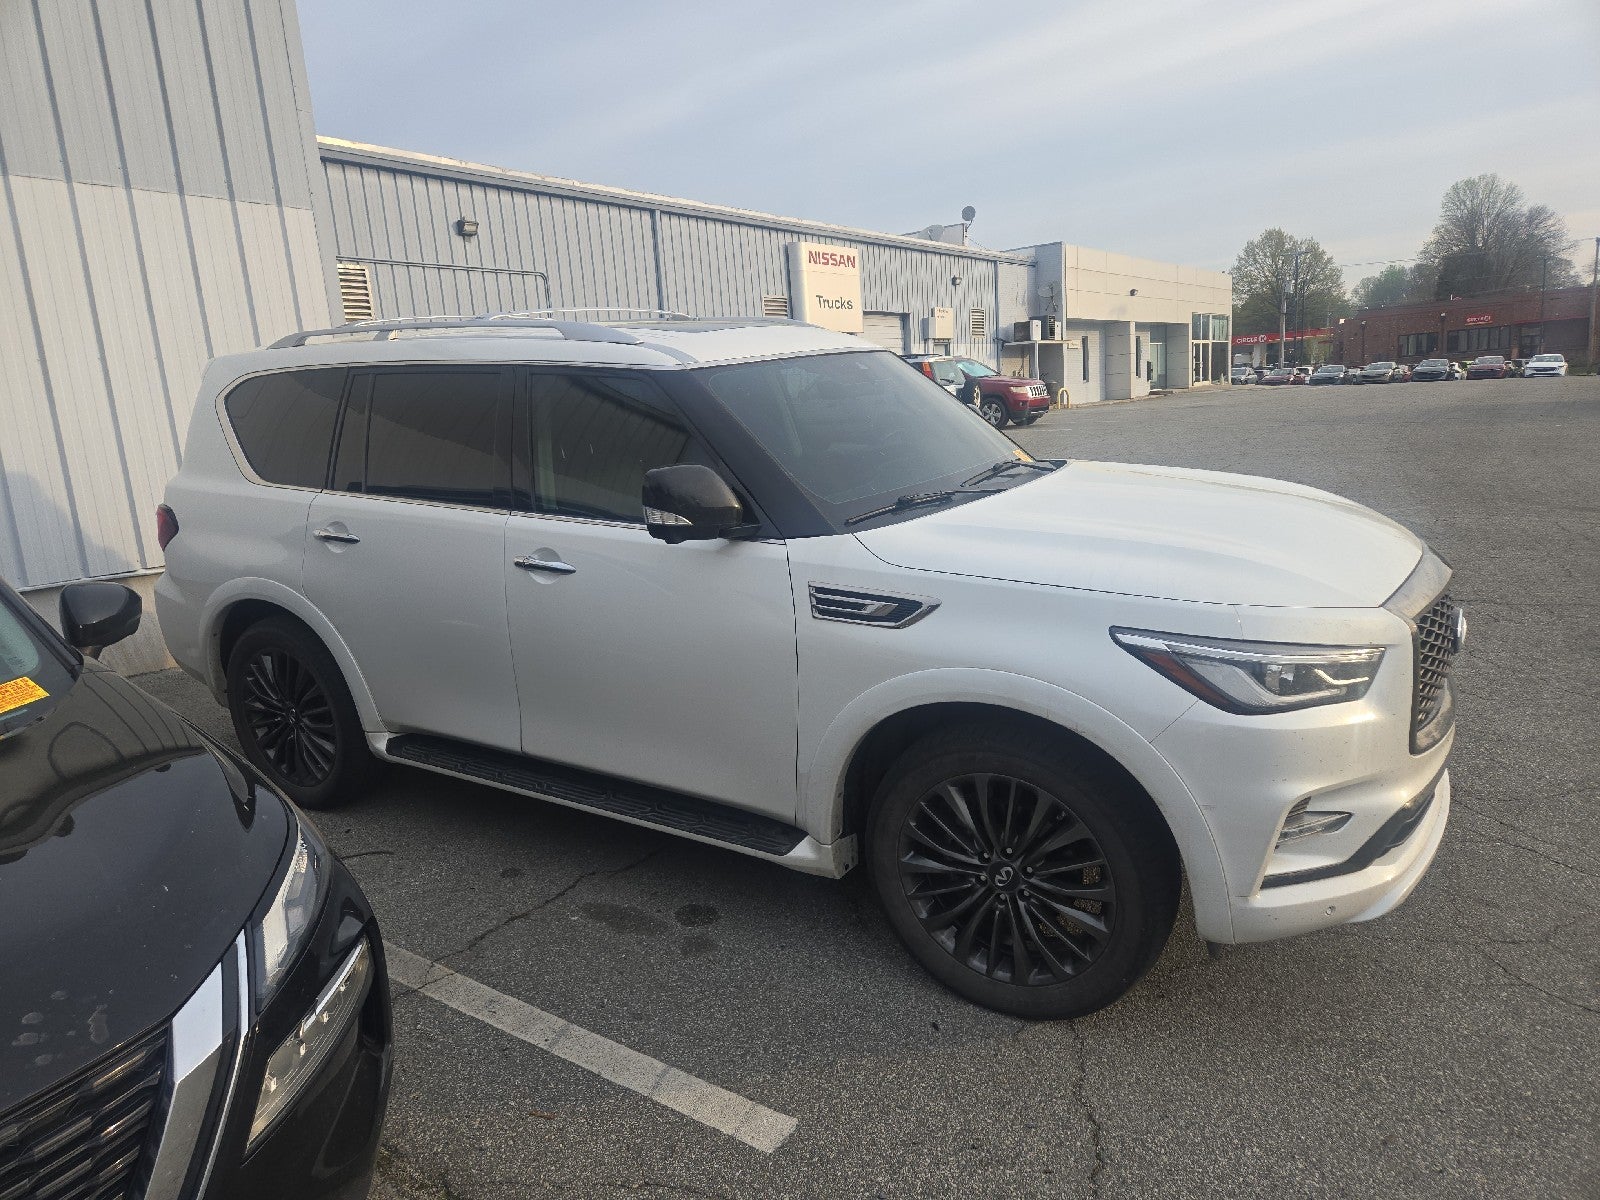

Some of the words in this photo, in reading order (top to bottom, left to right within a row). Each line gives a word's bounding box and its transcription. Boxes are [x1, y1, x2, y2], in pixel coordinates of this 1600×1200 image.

[808, 250, 856, 268] NISSAN
[816, 295, 853, 309] Trucks
[1236, 336, 1258, 344] CIRCLE
